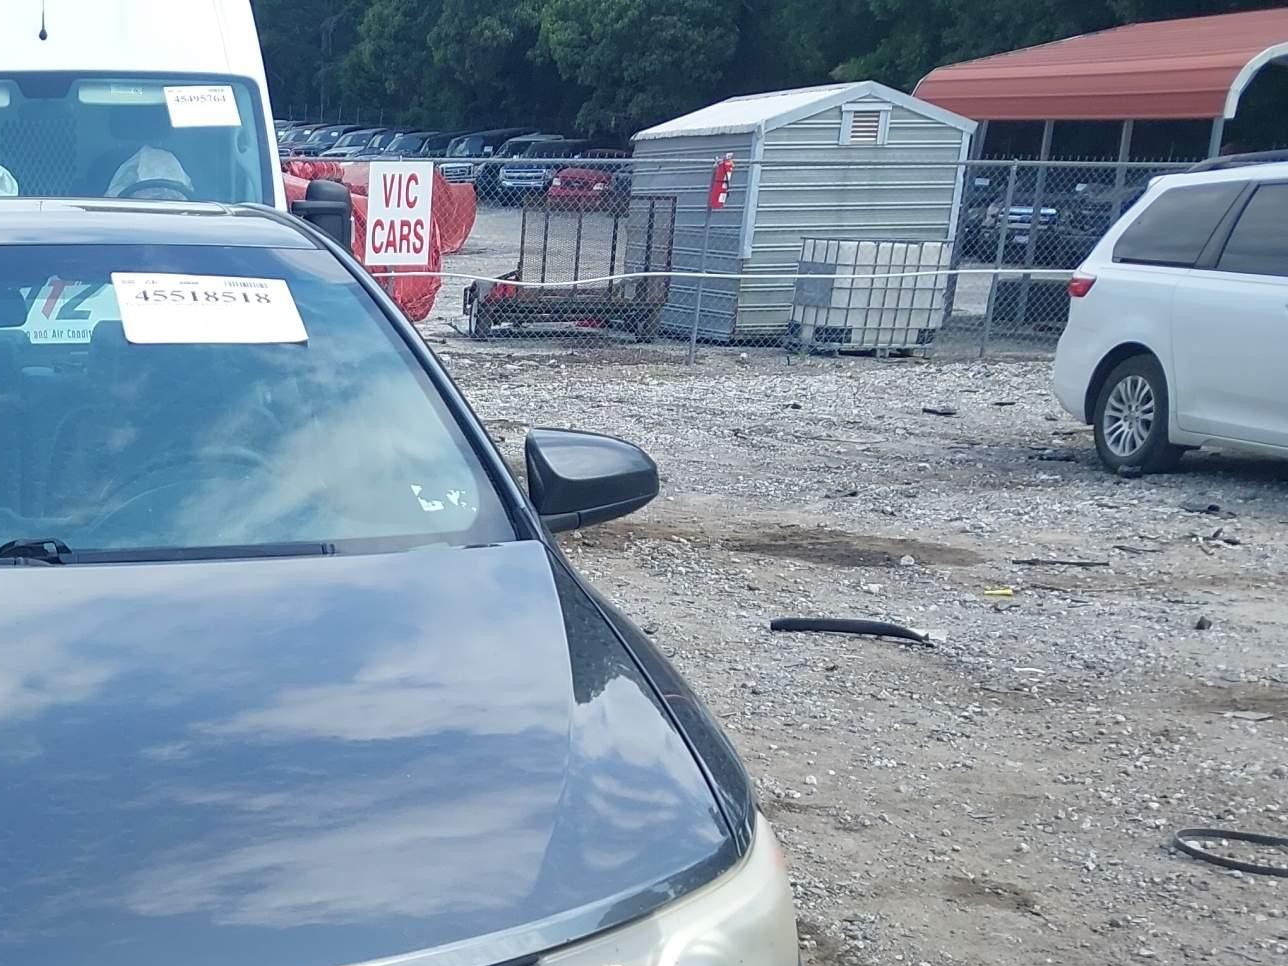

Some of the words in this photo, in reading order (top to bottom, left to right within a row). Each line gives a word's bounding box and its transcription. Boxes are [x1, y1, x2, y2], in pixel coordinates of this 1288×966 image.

[382, 173, 420, 209] VIC
[371, 218, 425, 254] CARS
[134, 289, 272, 304] 45518518
[51, 329, 64, 339] Air
